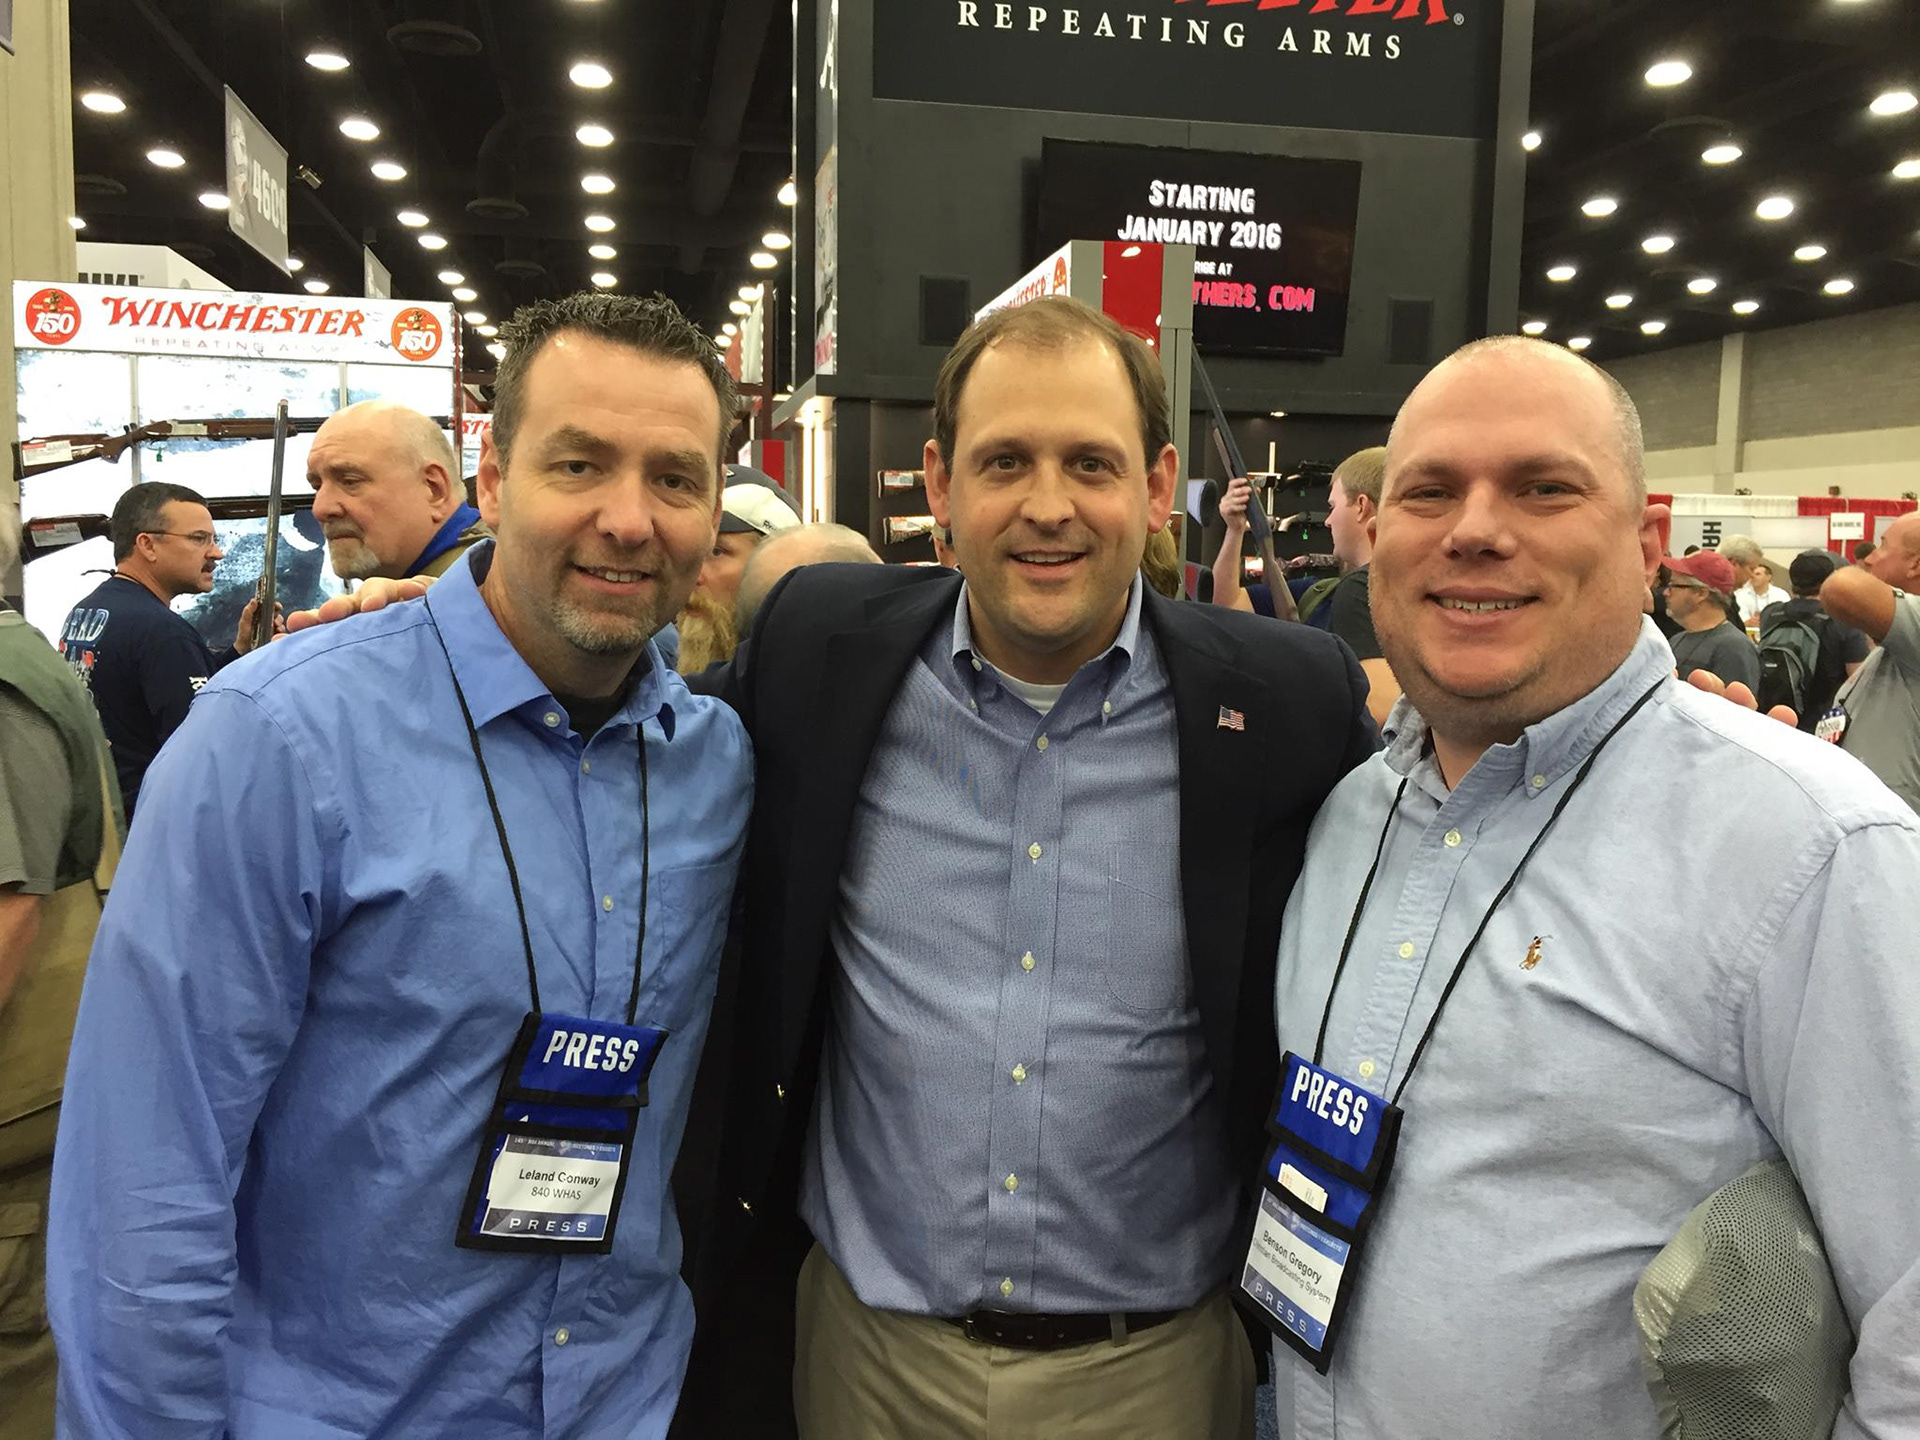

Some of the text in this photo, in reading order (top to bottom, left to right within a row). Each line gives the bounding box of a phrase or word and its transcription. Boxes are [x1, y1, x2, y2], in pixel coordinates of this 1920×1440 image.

[957, 0, 1246, 48] REPEATING
[1277, 26, 1401, 60] ARMS
[1148, 179, 1256, 214] STARTING
[1117, 214, 1283, 250] JANUARY 2016
[1217, 262, 1234, 277] AT
[1192, 281, 1315, 312] THERS. COM
[33, 311, 76, 335] 150
[101, 296, 366, 338] WINCHESTER
[397, 329, 437, 353] 150
[542, 1030, 640, 1073] PRESS
[1291, 1064, 1369, 1136] PRESS
[518, 1168, 601, 1188] Leland Conway
[531, 1186, 582, 1200] 840 WHAS
[509, 1217, 588, 1233] PRESS
[1262, 1229, 1289, 1259] Benson
[1288, 1251, 1323, 1285] Gregory
[1270, 1253, 1305, 1289] Broadcasting
[1304, 1280, 1332, 1305] System
[1254, 1281, 1308, 1334] PRESS
